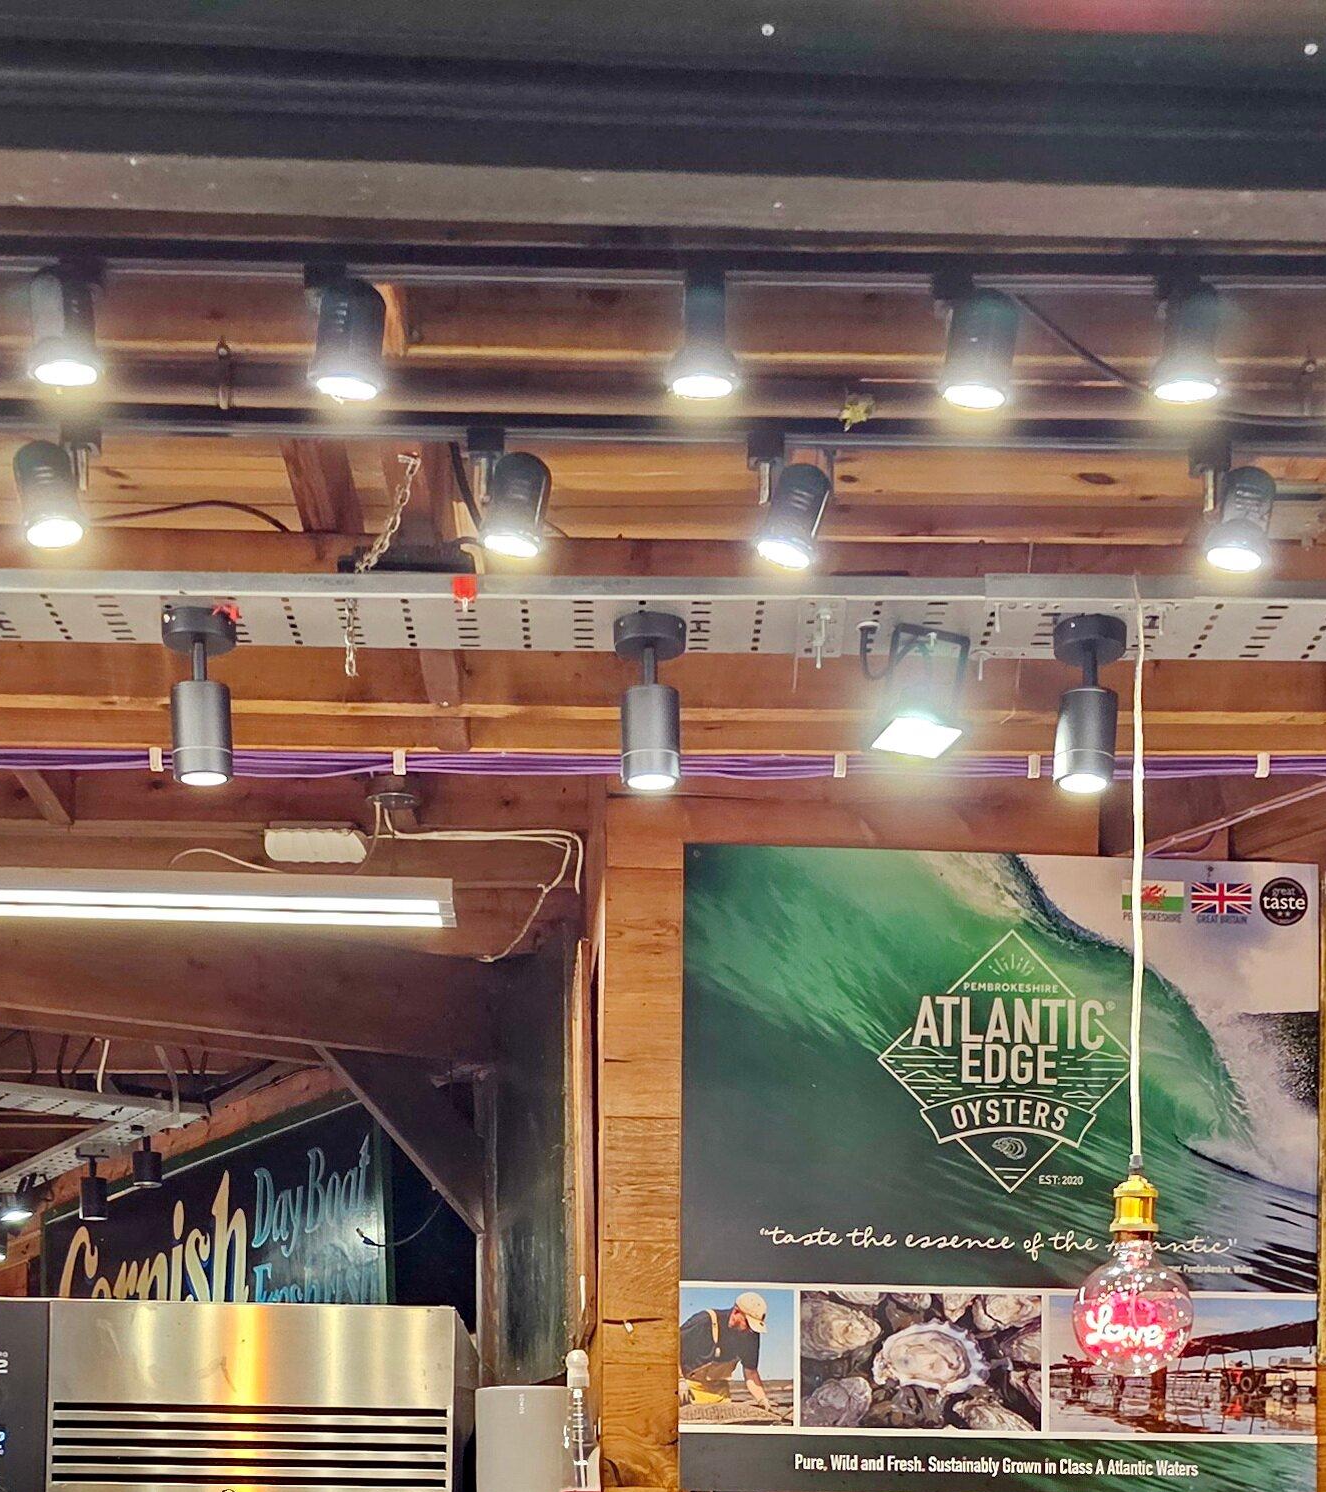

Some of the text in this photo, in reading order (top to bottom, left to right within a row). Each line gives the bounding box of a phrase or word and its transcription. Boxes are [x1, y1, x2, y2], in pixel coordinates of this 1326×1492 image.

[1262, 895, 1306, 910] taste
[962, 981, 1060, 993] PEMBROKESHIRE
[911, 994, 1106, 1051] ATLANTIC
[961, 1042, 1059, 1086] EDGE
[950, 1098, 1070, 1132] OYSTERS
[1062, 1175, 1084, 1186] 2020
[252, 1167, 304, 1258] Day
[845, 1225, 897, 1248] the
[905, 1232, 1015, 1250] essence
[1023, 1231, 1044, 1261] of
[1048, 1230, 1099, 1251] the
[1085, 1303, 1165, 1346] Love
[794, 1453, 828, 1472] Pure,
[830, 1454, 859, 1472] Wild
[860, 1454, 884, 1472] and
[927, 1455, 998, 1478] Sustainably
[1002, 1457, 1042, 1475] Grown
[1044, 1457, 1057, 1475] in
[1059, 1458, 1093, 1475] Class
[1095, 1458, 1105, 1475] A
[1107, 1458, 1154, 1476] Atlantic
[1155, 1459, 1199, 1477] Waters
